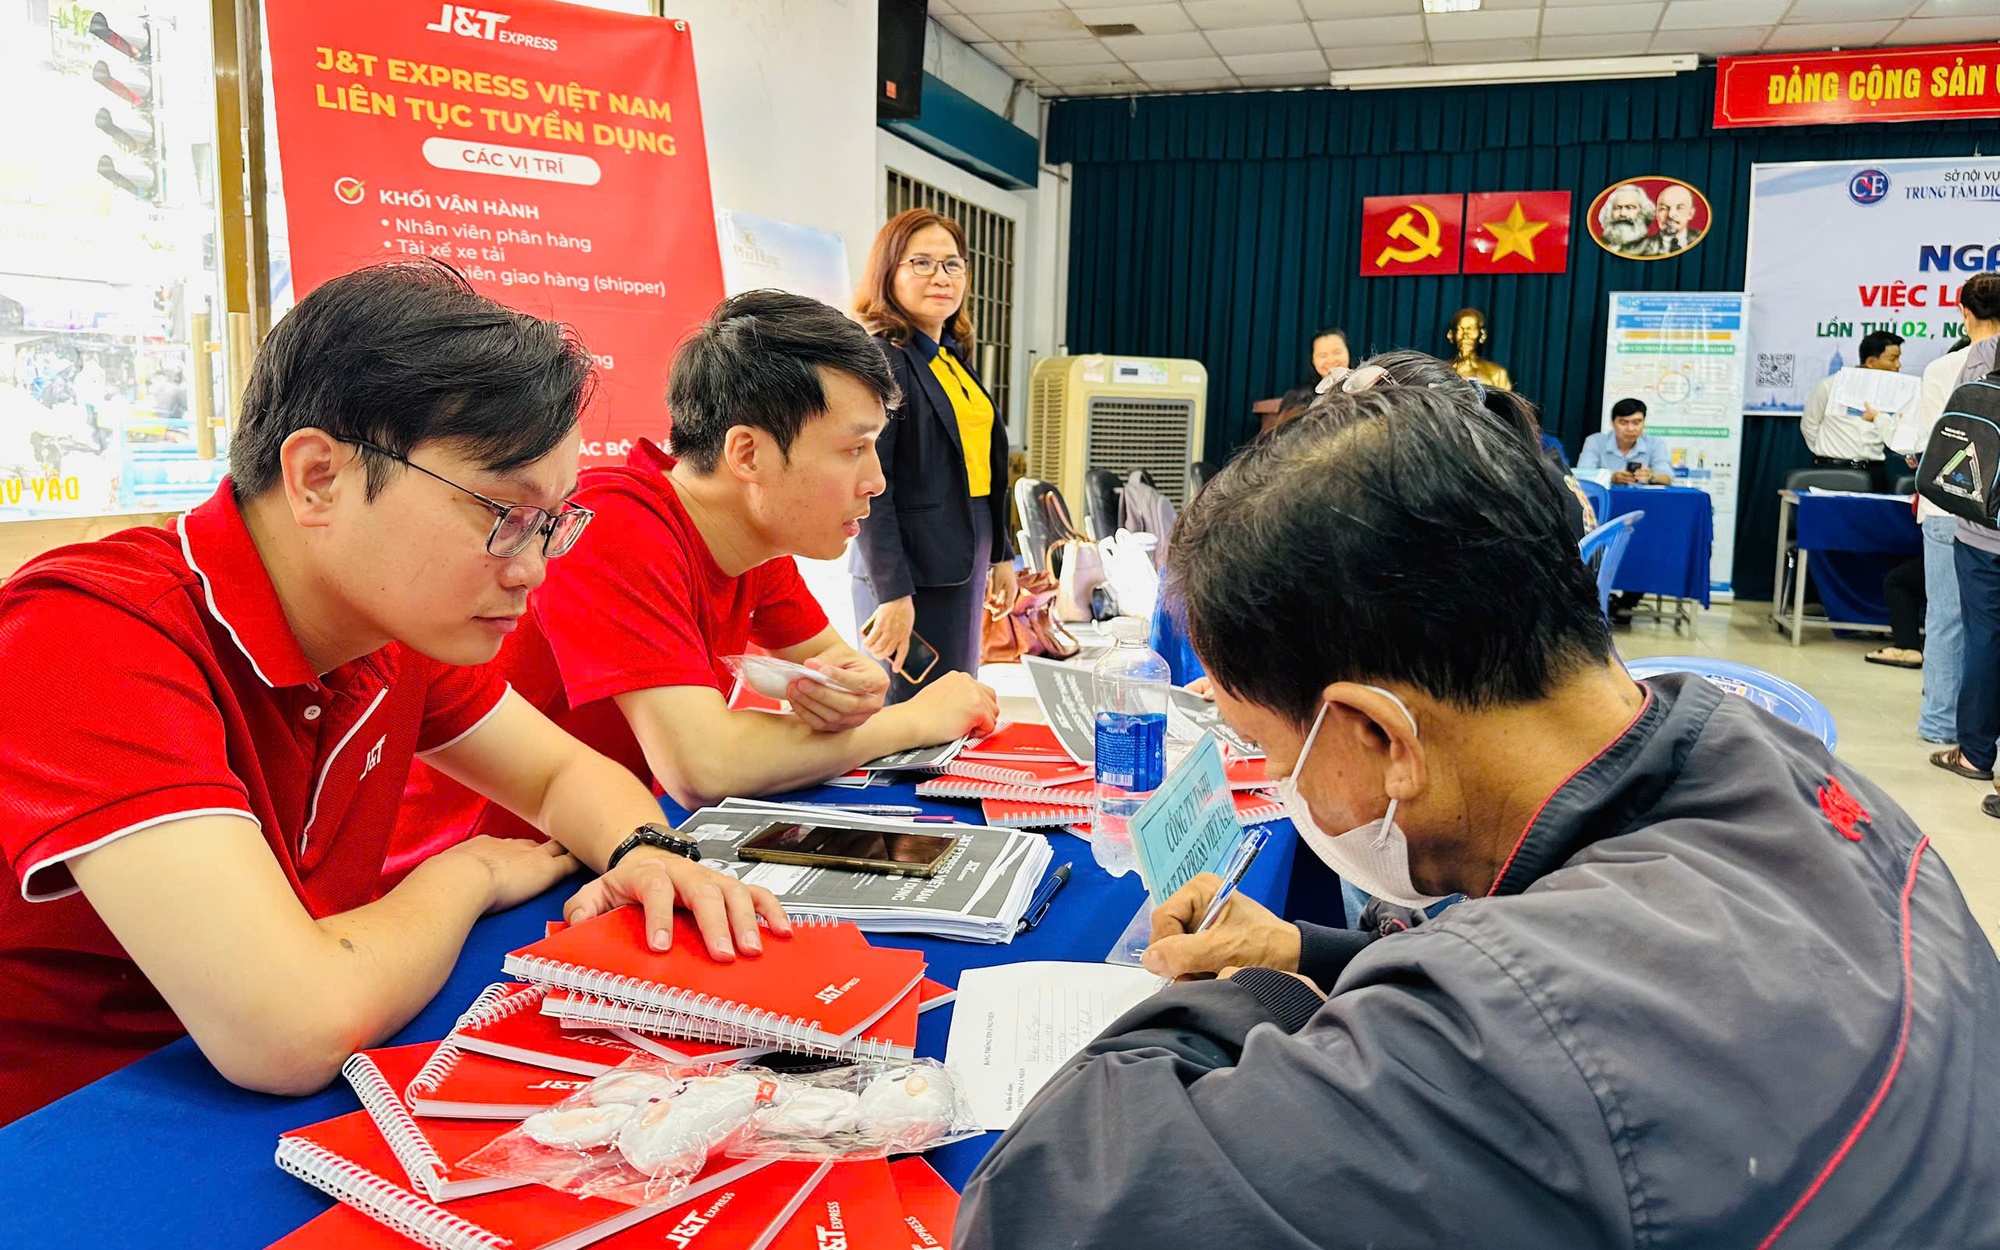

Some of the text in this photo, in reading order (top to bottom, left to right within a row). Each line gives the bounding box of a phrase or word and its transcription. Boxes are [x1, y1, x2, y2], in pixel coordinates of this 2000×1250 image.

[427, 4, 559, 52] J&T EXPRESS
[316, 47, 673, 123] J&T EXPRESS VIỆT NAM
[1768, 65, 1840, 105] ĐẢNG
[1848, 64, 1922, 107] CỘNG
[1930, 57, 1987, 98] SẢN
[316, 83, 678, 158] LIÊN TỤC TUYỂN DỤNG
[462, 145, 565, 176] CÁC VỊ TRÍ
[379, 189, 540, 220] KHỐI VẬN HÀNH
[1905, 186, 1947, 199] TRUNG
[396, 218, 592, 253] Nhân viên phân hàng
[397, 238, 505, 262] Tài xế xe tải
[501, 268, 540, 286] giao
[543, 271, 590, 292] hàng
[594, 275, 666, 298] (shipper)
[1858, 279, 1927, 313] VIỆC
[1816, 316, 1853, 338] LẦN
[579, 438, 602, 456] ÁC
[359, 733, 387, 781] J&T
[1164, 805, 1189, 853] CÔNG
[1184, 791, 1197, 827] TY
[814, 984, 844, 1005] J&T
[561, 1034, 624, 1046] J&T
[526, 1080, 589, 1090] J&T
[666, 1192, 735, 1250] J&T EXPRESS
[827, 1201, 844, 1229] EXPRESS
[904, 1216, 938, 1245] EXPRESS
